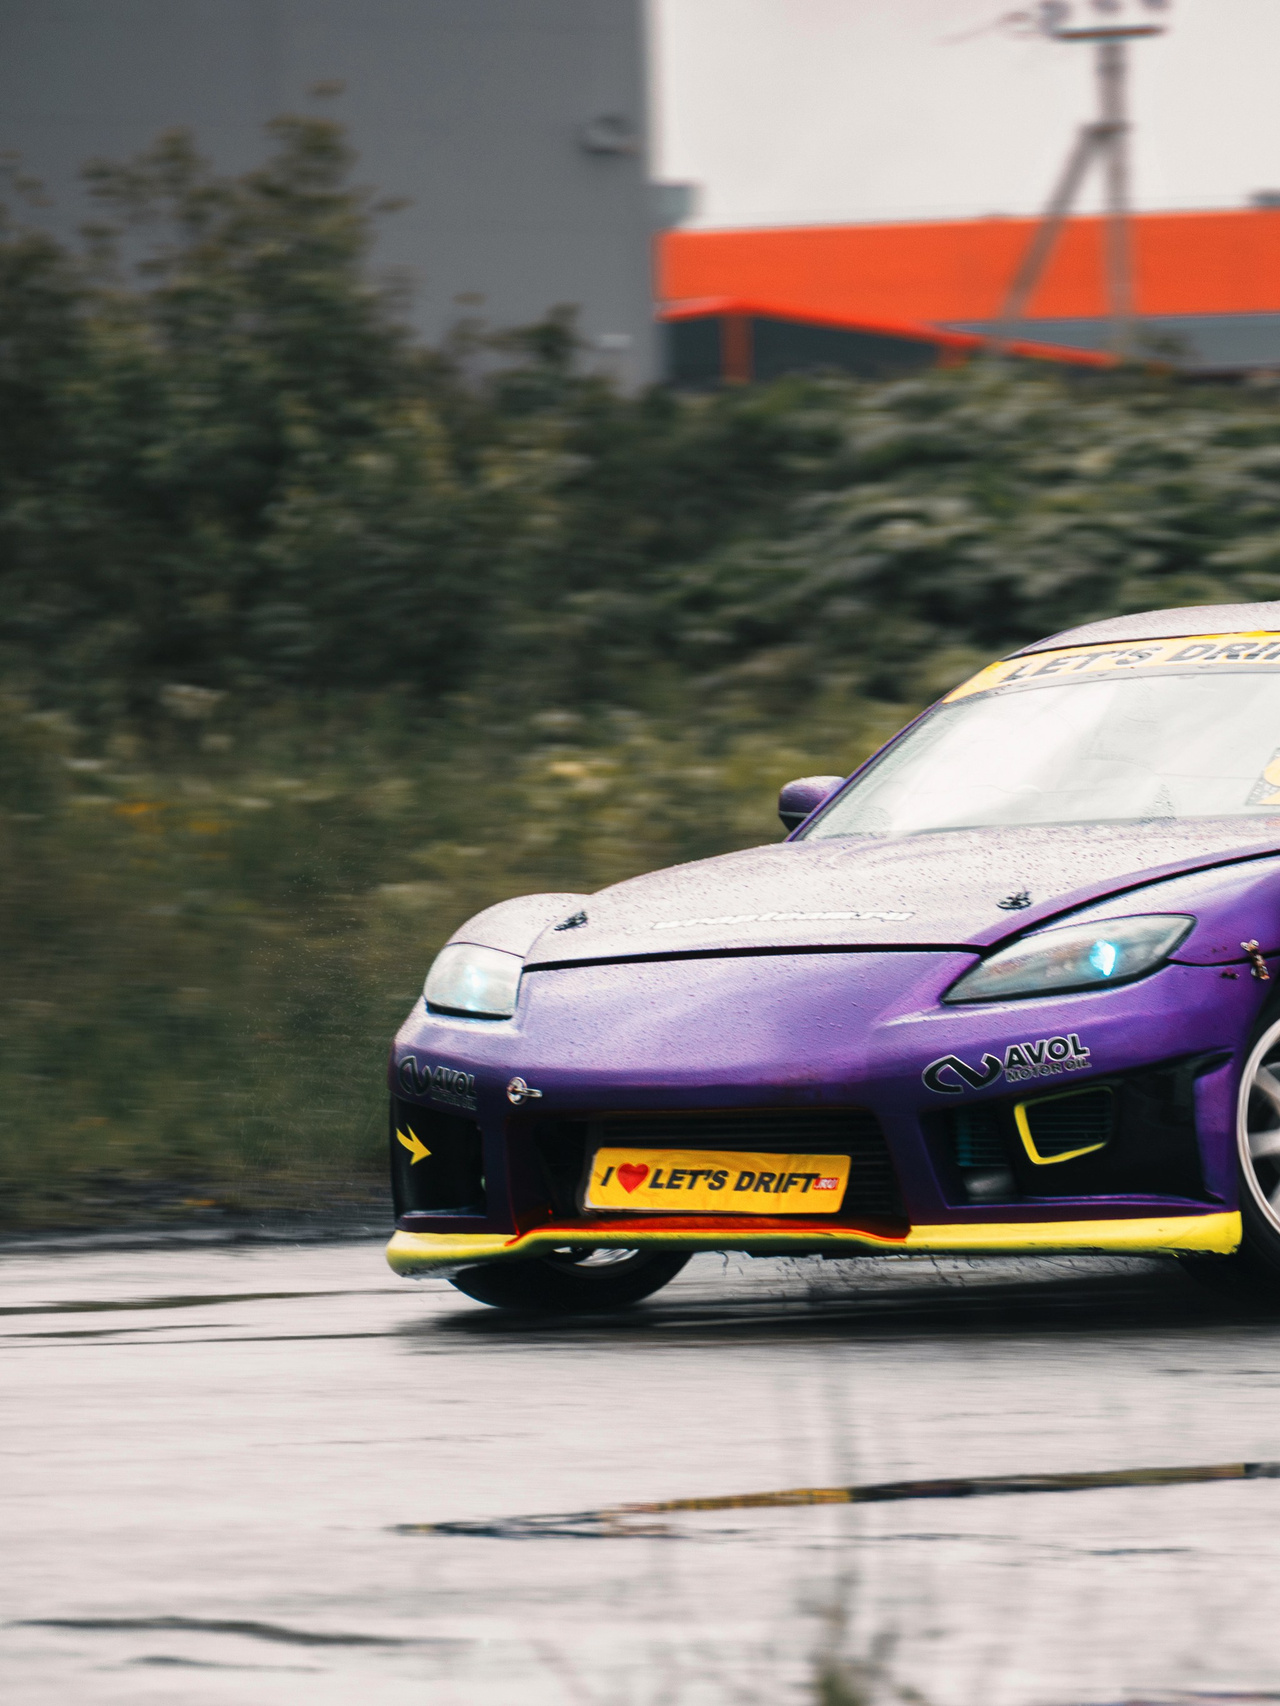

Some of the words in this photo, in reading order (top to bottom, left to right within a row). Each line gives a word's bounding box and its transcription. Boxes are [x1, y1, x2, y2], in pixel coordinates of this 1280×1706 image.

[998, 646, 1163, 684] LET'S
[1003, 1033, 1091, 1069] AVOL
[1005, 1062, 1063, 1083] MOTOR
[1062, 1056, 1092, 1072] OIL
[601, 1166, 616, 1186] I
[648, 1168, 730, 1191] LET'S
